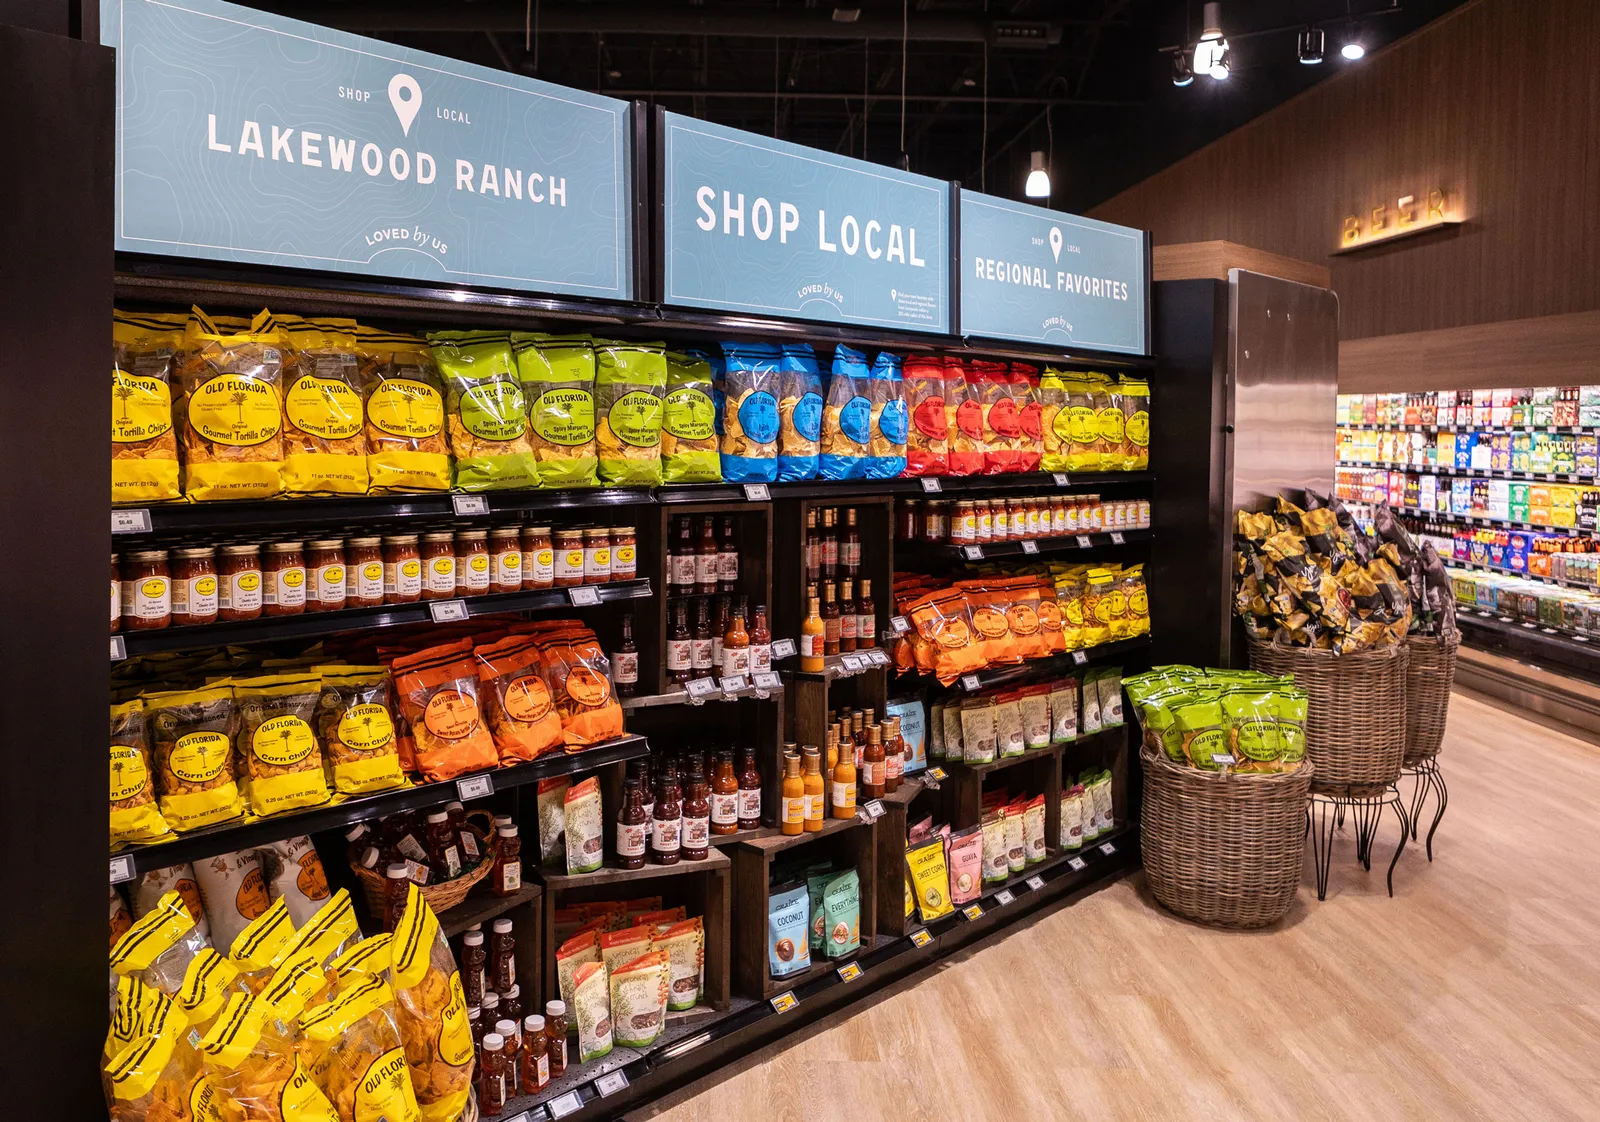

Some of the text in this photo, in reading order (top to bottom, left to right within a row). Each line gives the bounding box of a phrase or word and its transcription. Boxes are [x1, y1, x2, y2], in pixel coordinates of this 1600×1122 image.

[338, 86, 371, 102] SHOP
[436, 107, 471, 124] LOCAL
[207, 114, 567, 207] LAKEWOOD RANCH
[1343, 188, 1444, 243] BEER
[696, 186, 925, 267] SHOP LOCAL
[364, 225, 448, 255] LOVED by US
[1032, 237, 1044, 246] SHOP
[1067, 244, 1080, 254] LOCAL
[976, 257, 1128, 300] REGIONAL FAVORITES
[798, 282, 844, 303] LOVED by US
[1042, 317, 1059, 328] LOVED
[206, 381, 267, 395] OLD FLORIDA
[382, 384, 432, 397] OLD FLORIDA
[544, 394, 588, 405] OLD FLORIDA
[634, 398, 660, 407] FLORIDA
[119, 423, 167, 437] Tortilla Chips
[299, 419, 360, 434] Gourmet Tortilla Chips
[380, 420, 406, 431] Gourmet
[473, 424, 517, 436] Gourmet Tortill
[671, 427, 692, 435] Gourmet
[203, 425, 276, 441] Gourmet Tortilla Chips
[544, 430, 586, 441] Gourmet Tortilla
[620, 430, 640, 441] Gourmet
[358, 707, 383, 716] FLORIDA
[262, 719, 302, 732] OLD FLORIDA
[900, 721, 920, 732] COCONUT
[179, 735, 221, 748] OLD FLORIDA
[372, 733, 390, 745] Chips
[1206, 734, 1223, 742] FLORI
[262, 746, 311, 762] Corn Chips
[177, 762, 225, 778] Corn Chips
[121, 780, 145, 796] Chips
[962, 853, 977, 862] GUAVA
[917, 863, 944, 880] SWEET CORN
[777, 911, 804, 927] COCONUT
[294, 1072, 308, 1088] OL
[365, 1055, 407, 1093] OLD FLORI
